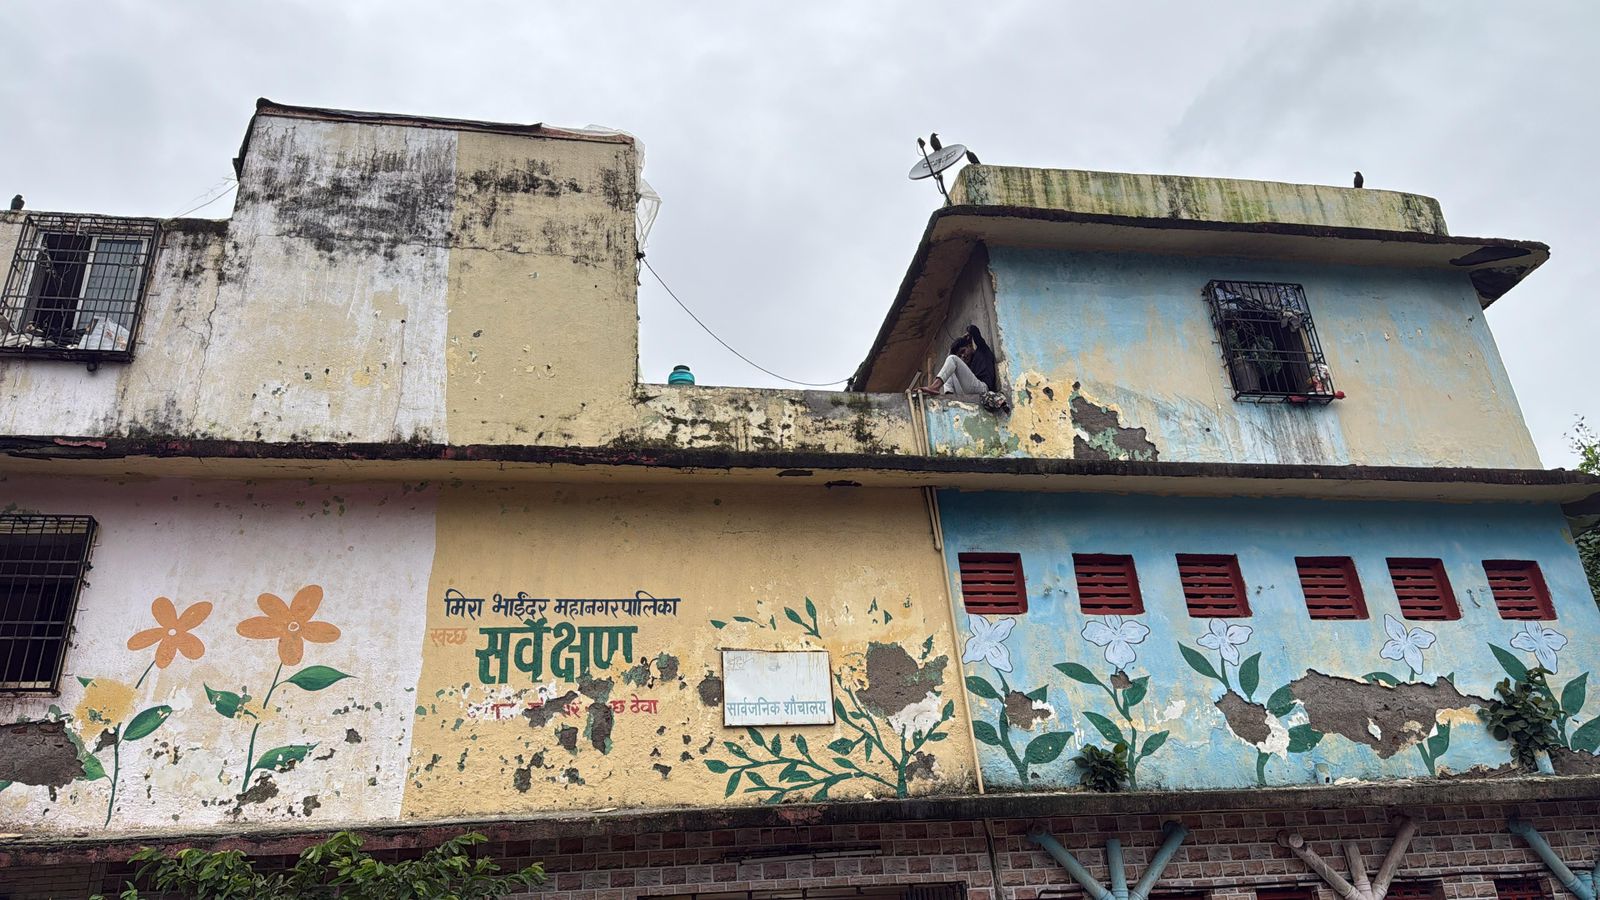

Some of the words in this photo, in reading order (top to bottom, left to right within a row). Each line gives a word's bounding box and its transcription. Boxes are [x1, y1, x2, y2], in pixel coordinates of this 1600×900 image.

[444, 589, 485, 620] मिरा
[553, 590, 681, 620] महानगरपालिका
[430, 627, 468, 647] स्वच्छ
[475, 618, 638, 684] सर्वेक्षण
[631, 694, 659, 714] ठेवा
[726, 697, 780, 716] सार्वजनिक
[784, 696, 826, 715] शौचालय
